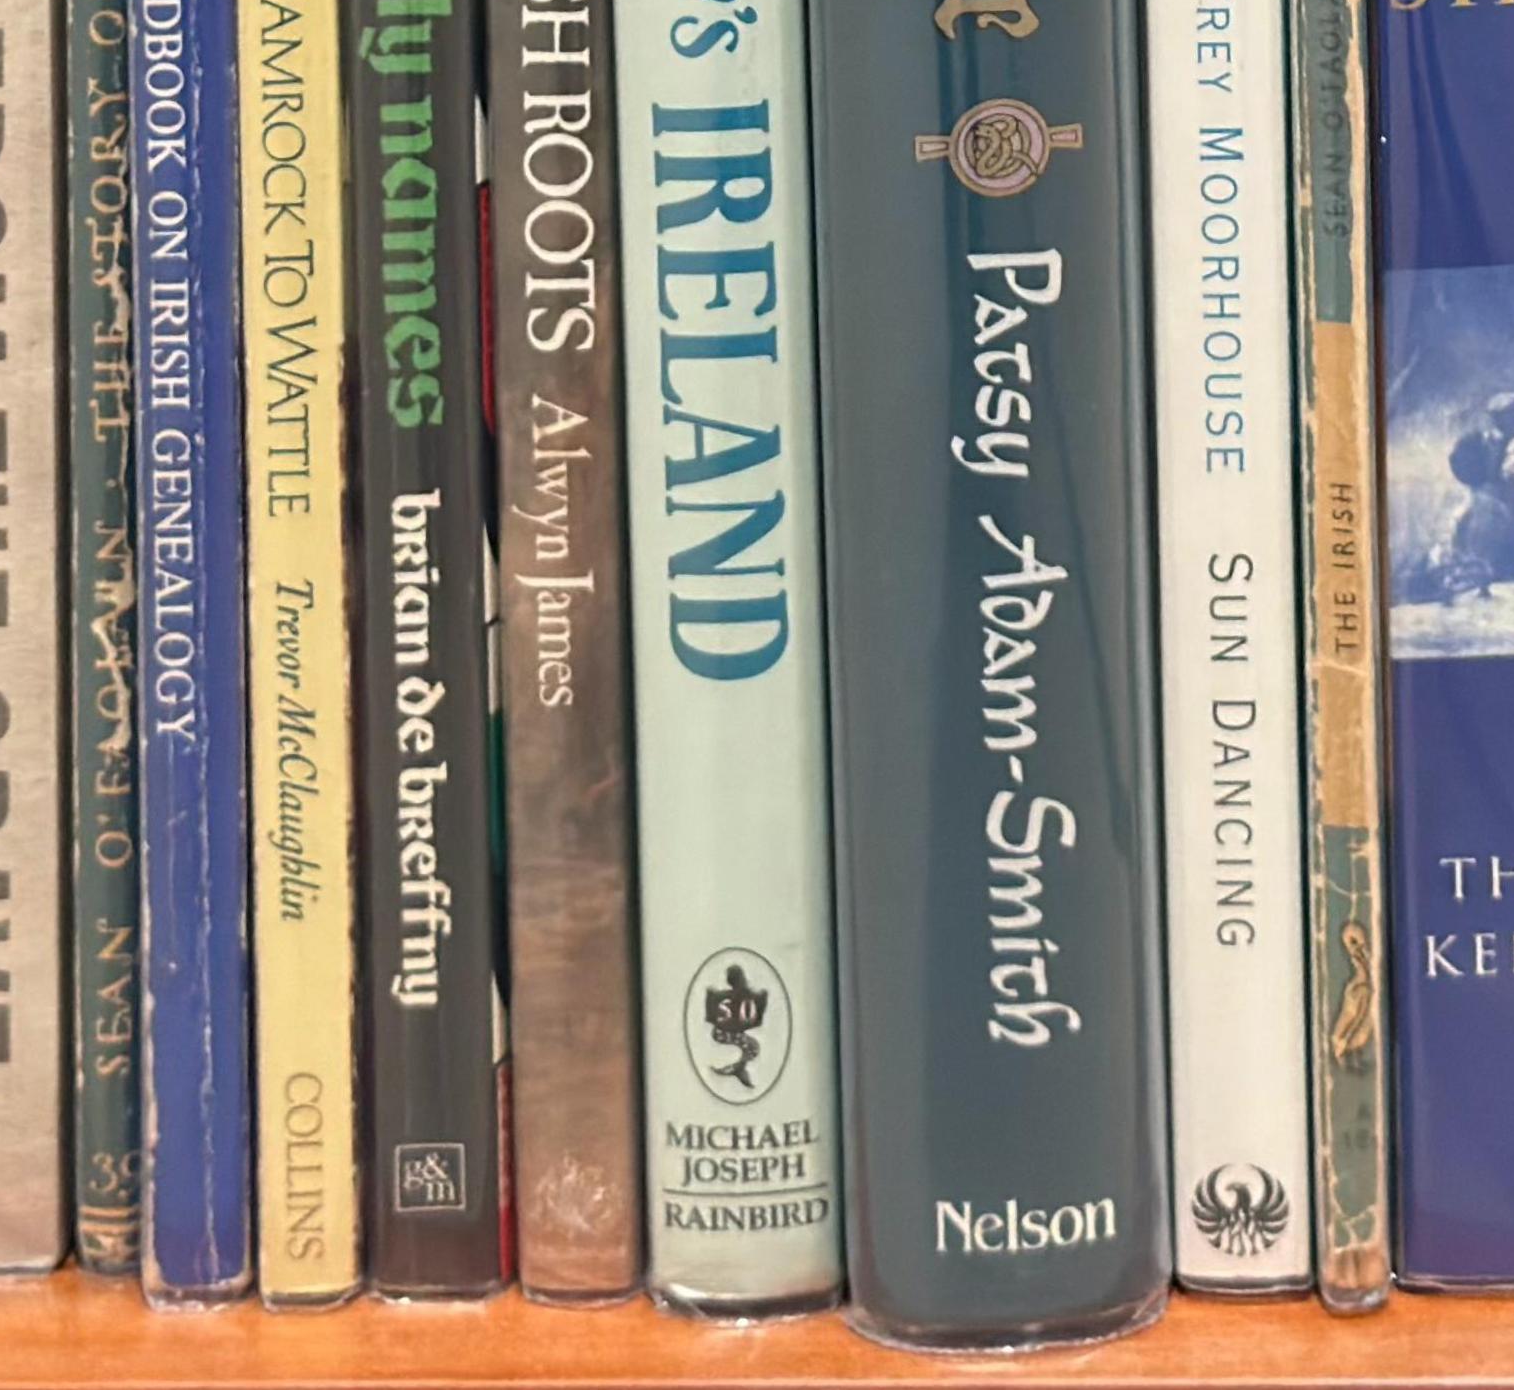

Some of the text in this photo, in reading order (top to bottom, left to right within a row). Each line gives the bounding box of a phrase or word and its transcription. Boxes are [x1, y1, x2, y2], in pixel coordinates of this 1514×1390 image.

[85, 84, 131, 288] STORY
[147, 190, 189, 262] ON
[380, 94, 444, 428] names
[521, 88, 596, 354] ROOTS
[87, 320, 132, 443] THE
[149, 279, 191, 408] IRISH
[650, 98, 792, 682] IRELAND
[1197, 126, 1247, 476] MOORHOUSE
[264, 314, 320, 517] WATTLE
[152, 427, 198, 743] GENEALOGY
[390, 487, 441, 664] brian
[511, 393, 595, 708] Alwyn James
[949, 246, 1083, 1048] Patsy Adam-Smith
[1330, 482, 1360, 655] THE IRISH
[267, 578, 322, 922] Trevor McClaughlin
[1206, 550, 1257, 950] SUN DANCING
[390, 766, 451, 1006] breffny
[95, 917, 133, 1076] SEAN
[284, 1070, 326, 1262] COLLINS
[663, 1197, 830, 1232] RAINBIRD
[664, 1120, 819, 1151] MICHAEL
[679, 1154, 807, 1186] JOSEPH
[935, 1196, 1118, 1254] Nelson
